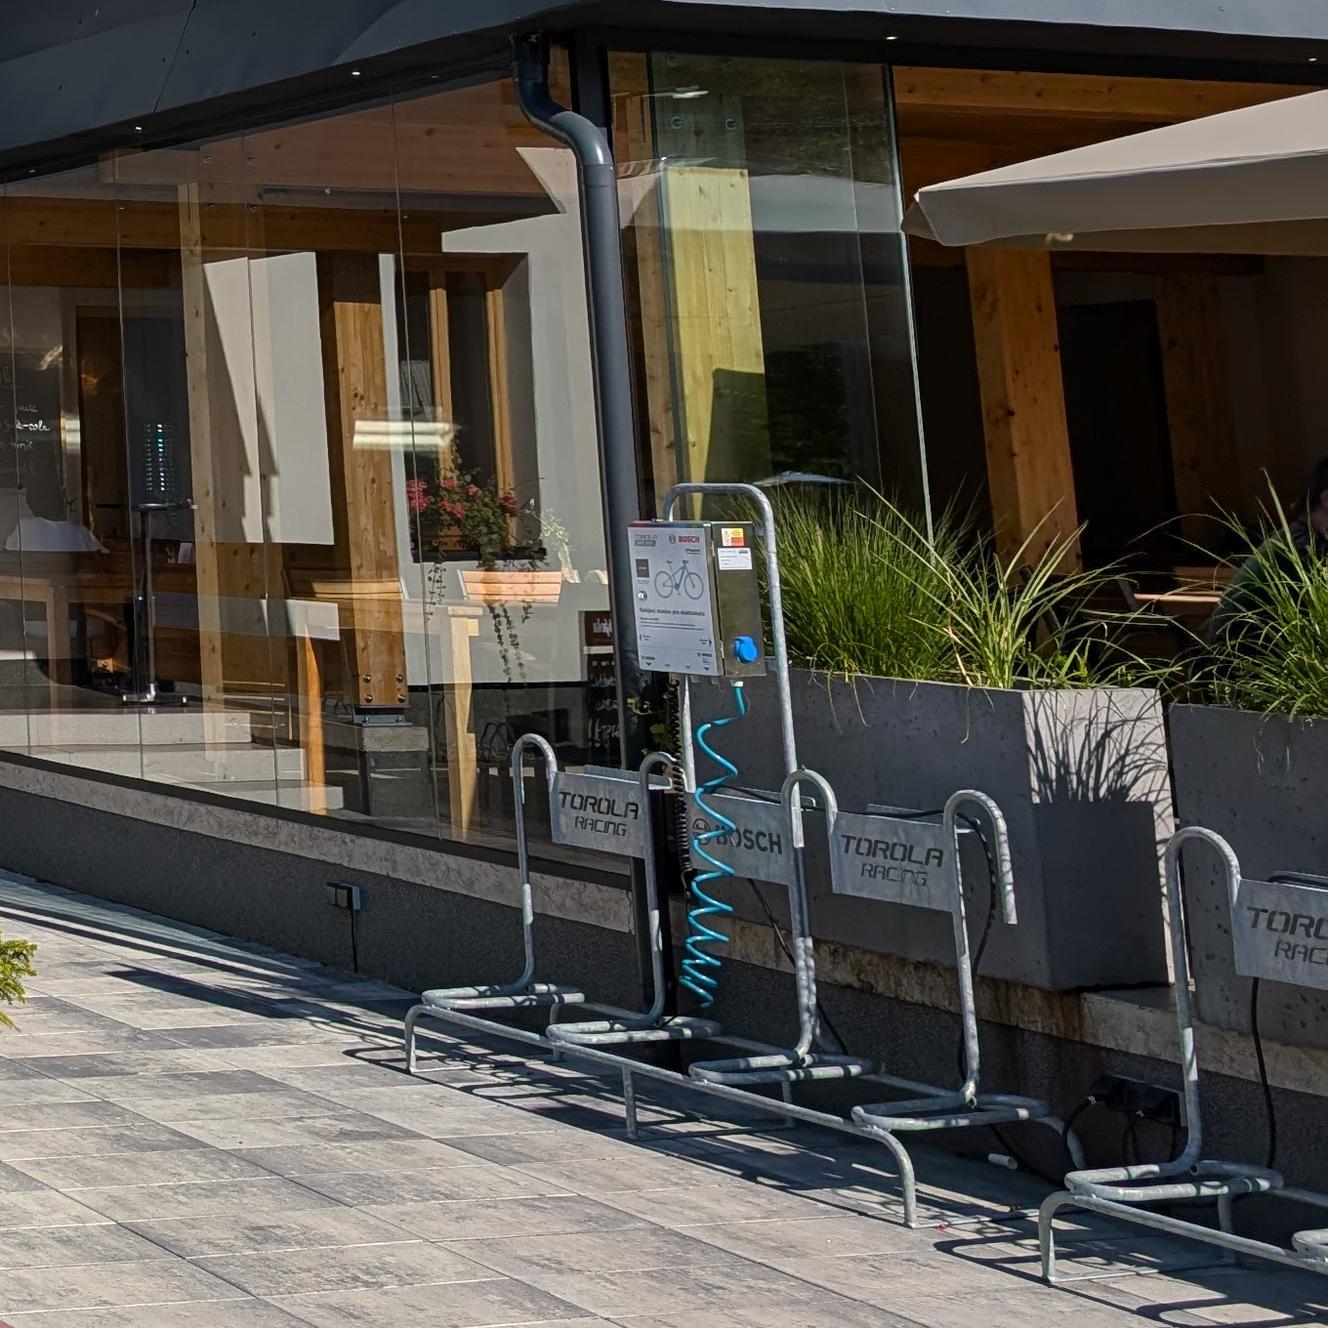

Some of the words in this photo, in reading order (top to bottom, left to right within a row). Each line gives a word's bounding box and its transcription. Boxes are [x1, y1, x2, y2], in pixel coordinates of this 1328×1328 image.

[678, 535, 700, 543] BOSCH
[559, 791, 639, 820] TOROLA
[574, 815, 627, 836] RACING
[841, 834, 944, 868] TOROLA
[861, 862, 928, 886] RACING
